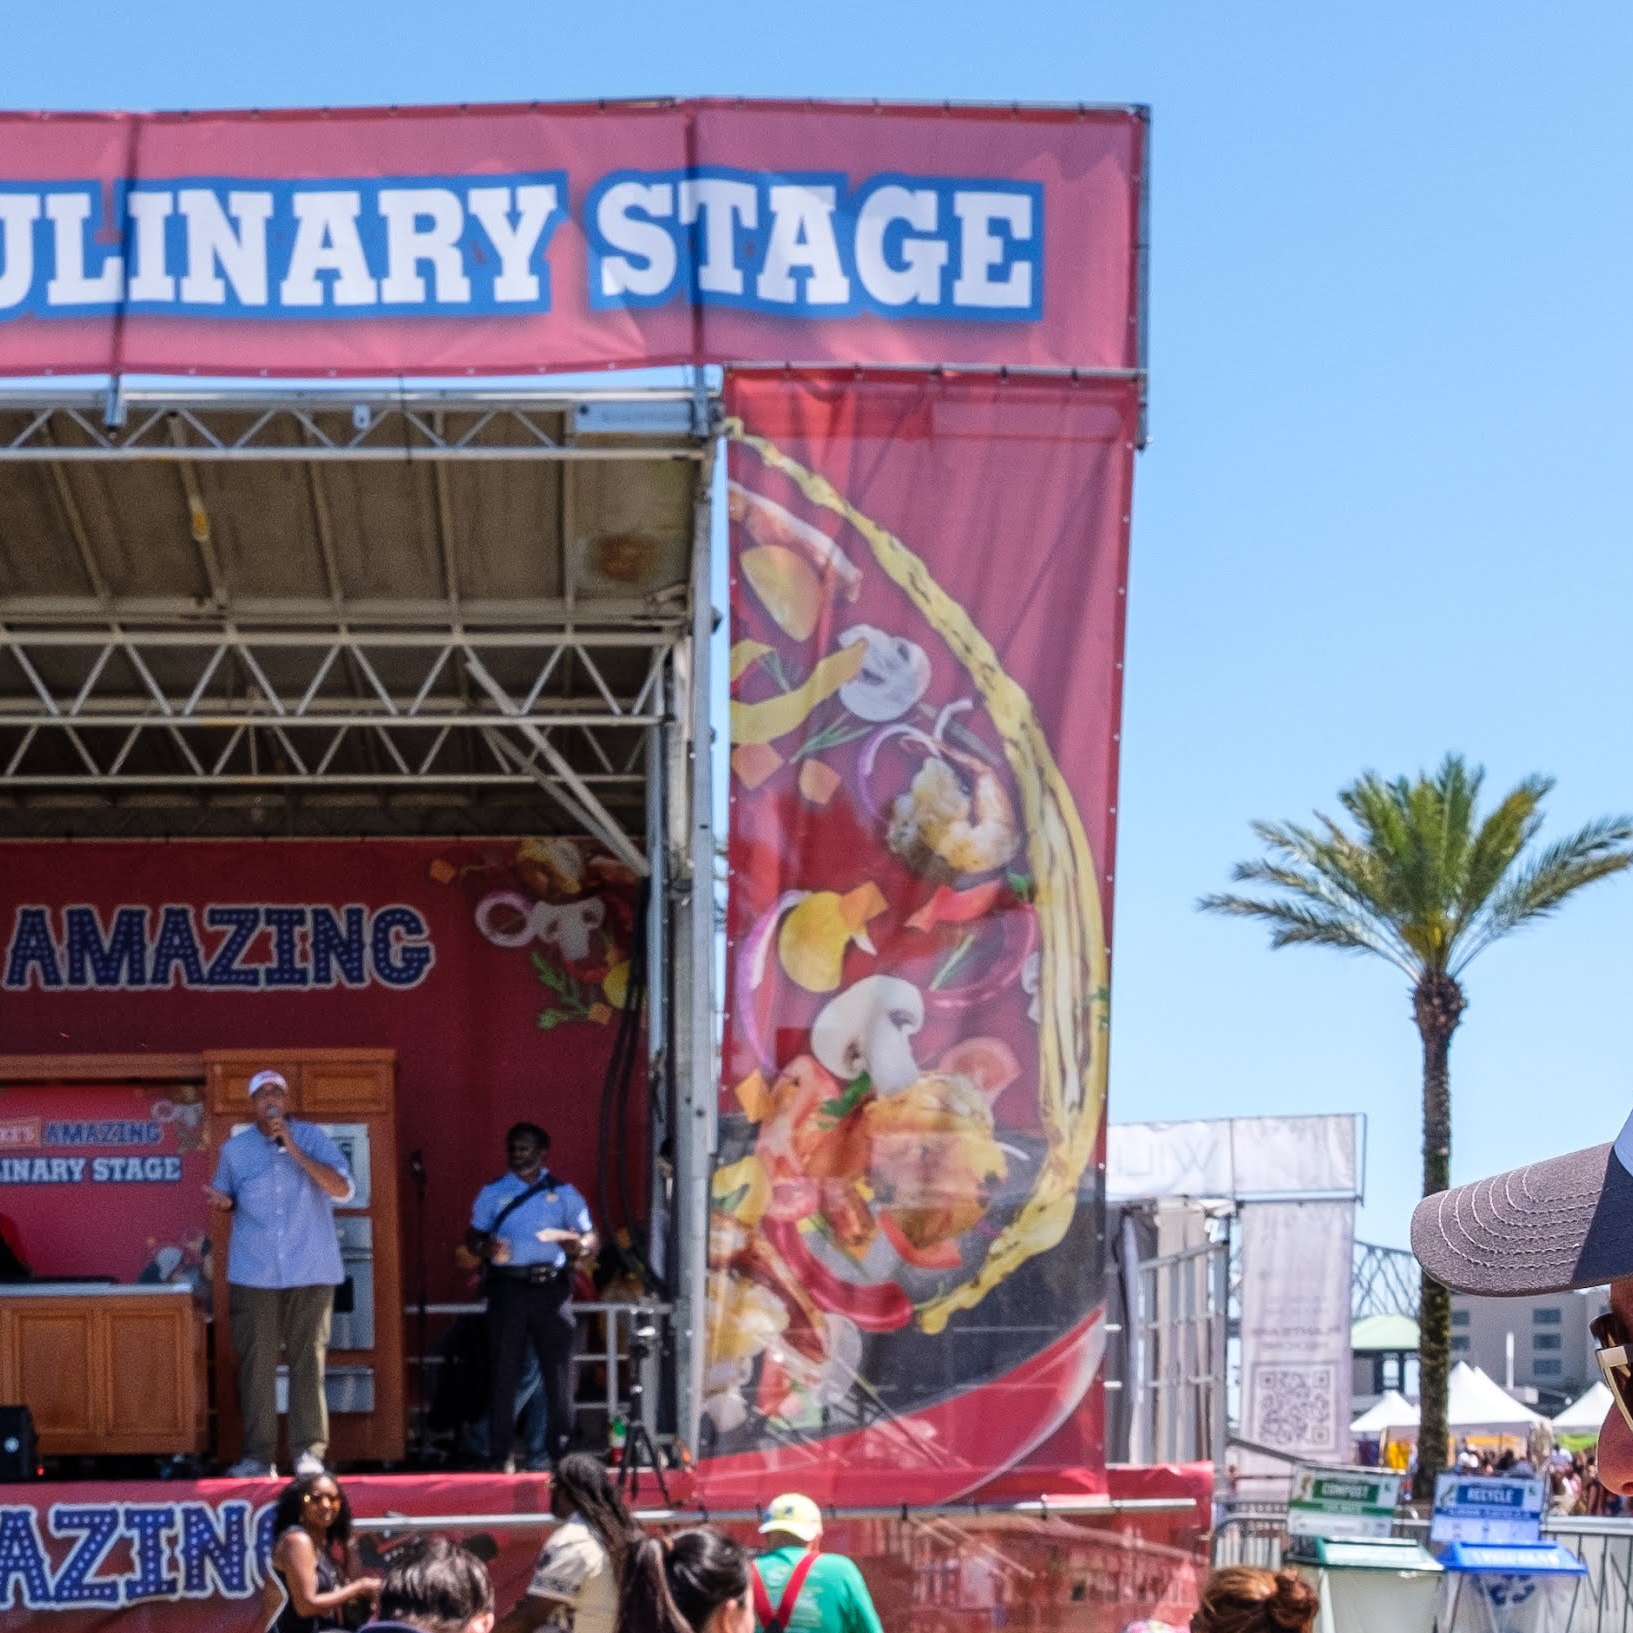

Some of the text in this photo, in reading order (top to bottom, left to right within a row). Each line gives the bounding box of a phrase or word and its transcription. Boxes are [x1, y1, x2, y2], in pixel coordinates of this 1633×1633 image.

[599, 180, 1034, 309] STAGE
[4, 904, 436, 991] AMAZING
[42, 1120, 164, 1146] AMAZING
[91, 1156, 181, 1182] STAGE
